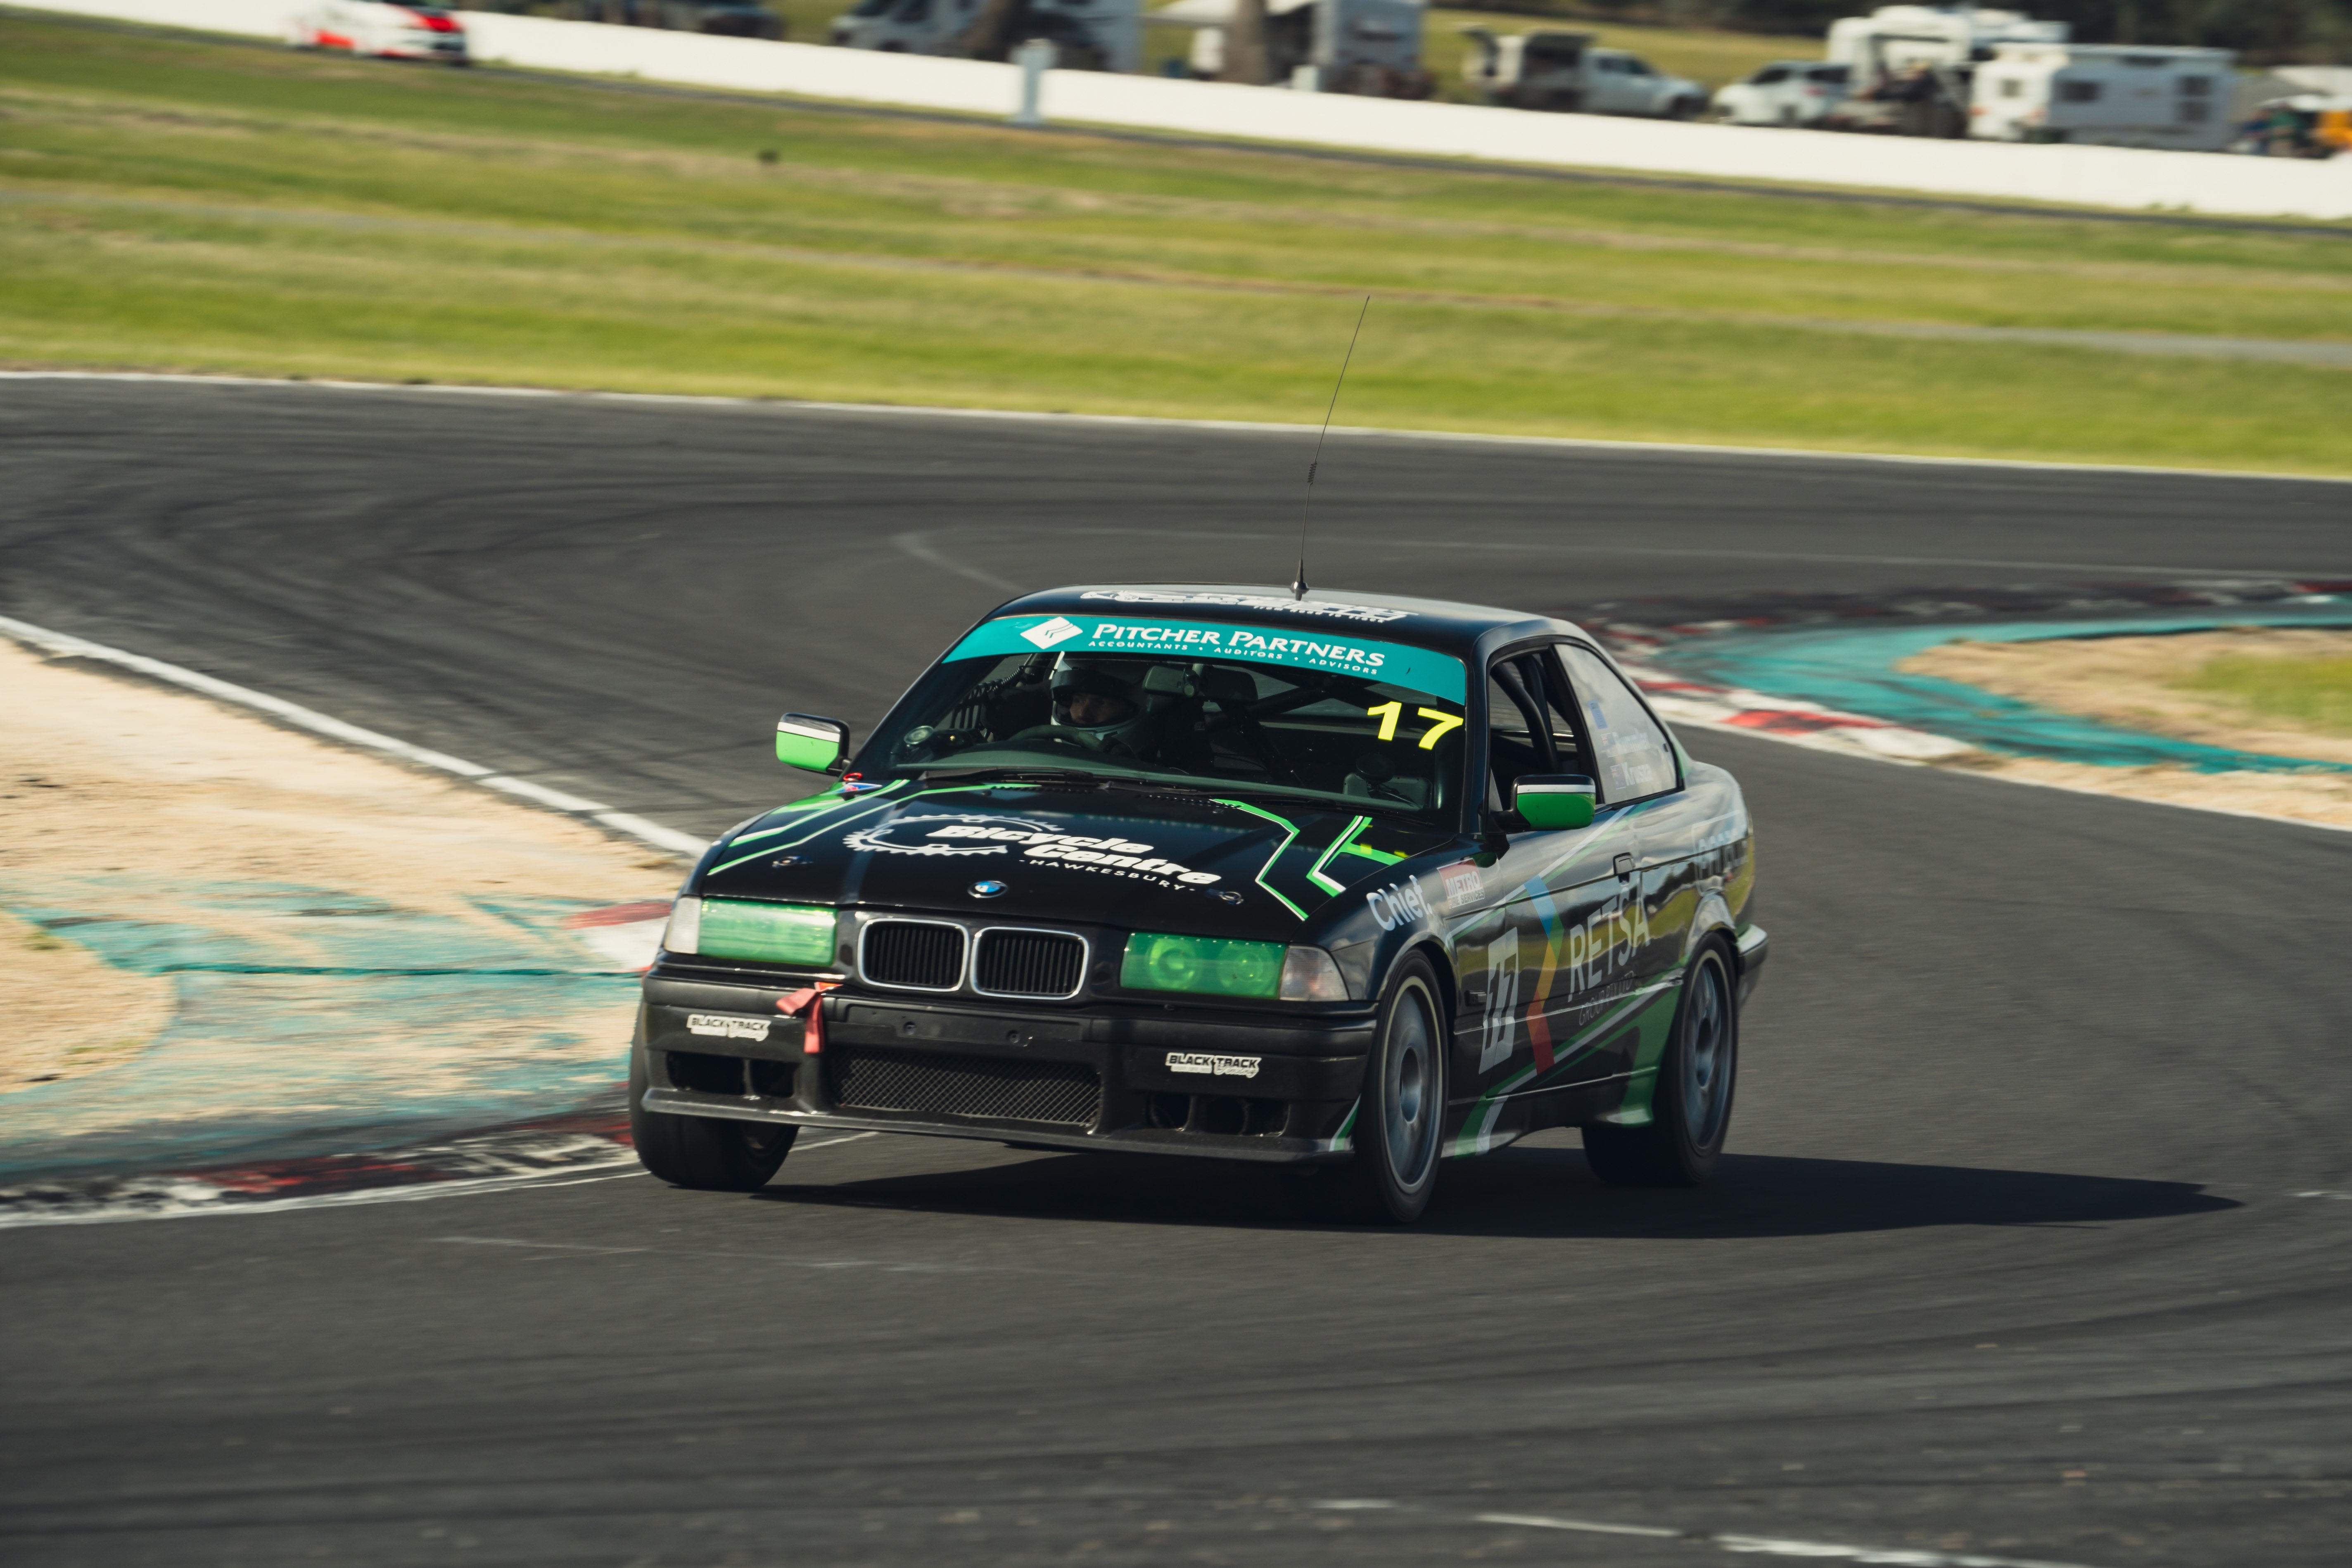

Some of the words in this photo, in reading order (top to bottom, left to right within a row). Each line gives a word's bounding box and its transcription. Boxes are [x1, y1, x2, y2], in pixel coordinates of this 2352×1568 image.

[1088, 641, 1188, 650] ACCOUNTANTS
[1214, 647, 1282, 659] AUDITORS
[1309, 658, 1377, 675] ADVISORS
[1092, 624, 1220, 644] PITCHER
[1228, 631, 1385, 666] PARTNERS
[1367, 701, 1464, 750] 17
[926, 825, 1154, 854] Bicycle
[1023, 844, 1221, 885] Centre
[1445, 871, 1481, 896] METRO
[1460, 889, 1485, 905] SERVICES
[1568, 871, 1651, 1002] RETSA
[1484, 953, 1517, 1051] 17
[1578, 989, 1605, 1026] GROUP
[1169, 1055, 1211, 1066] BLACK
[1217, 1058, 1258, 1068] TRACK
